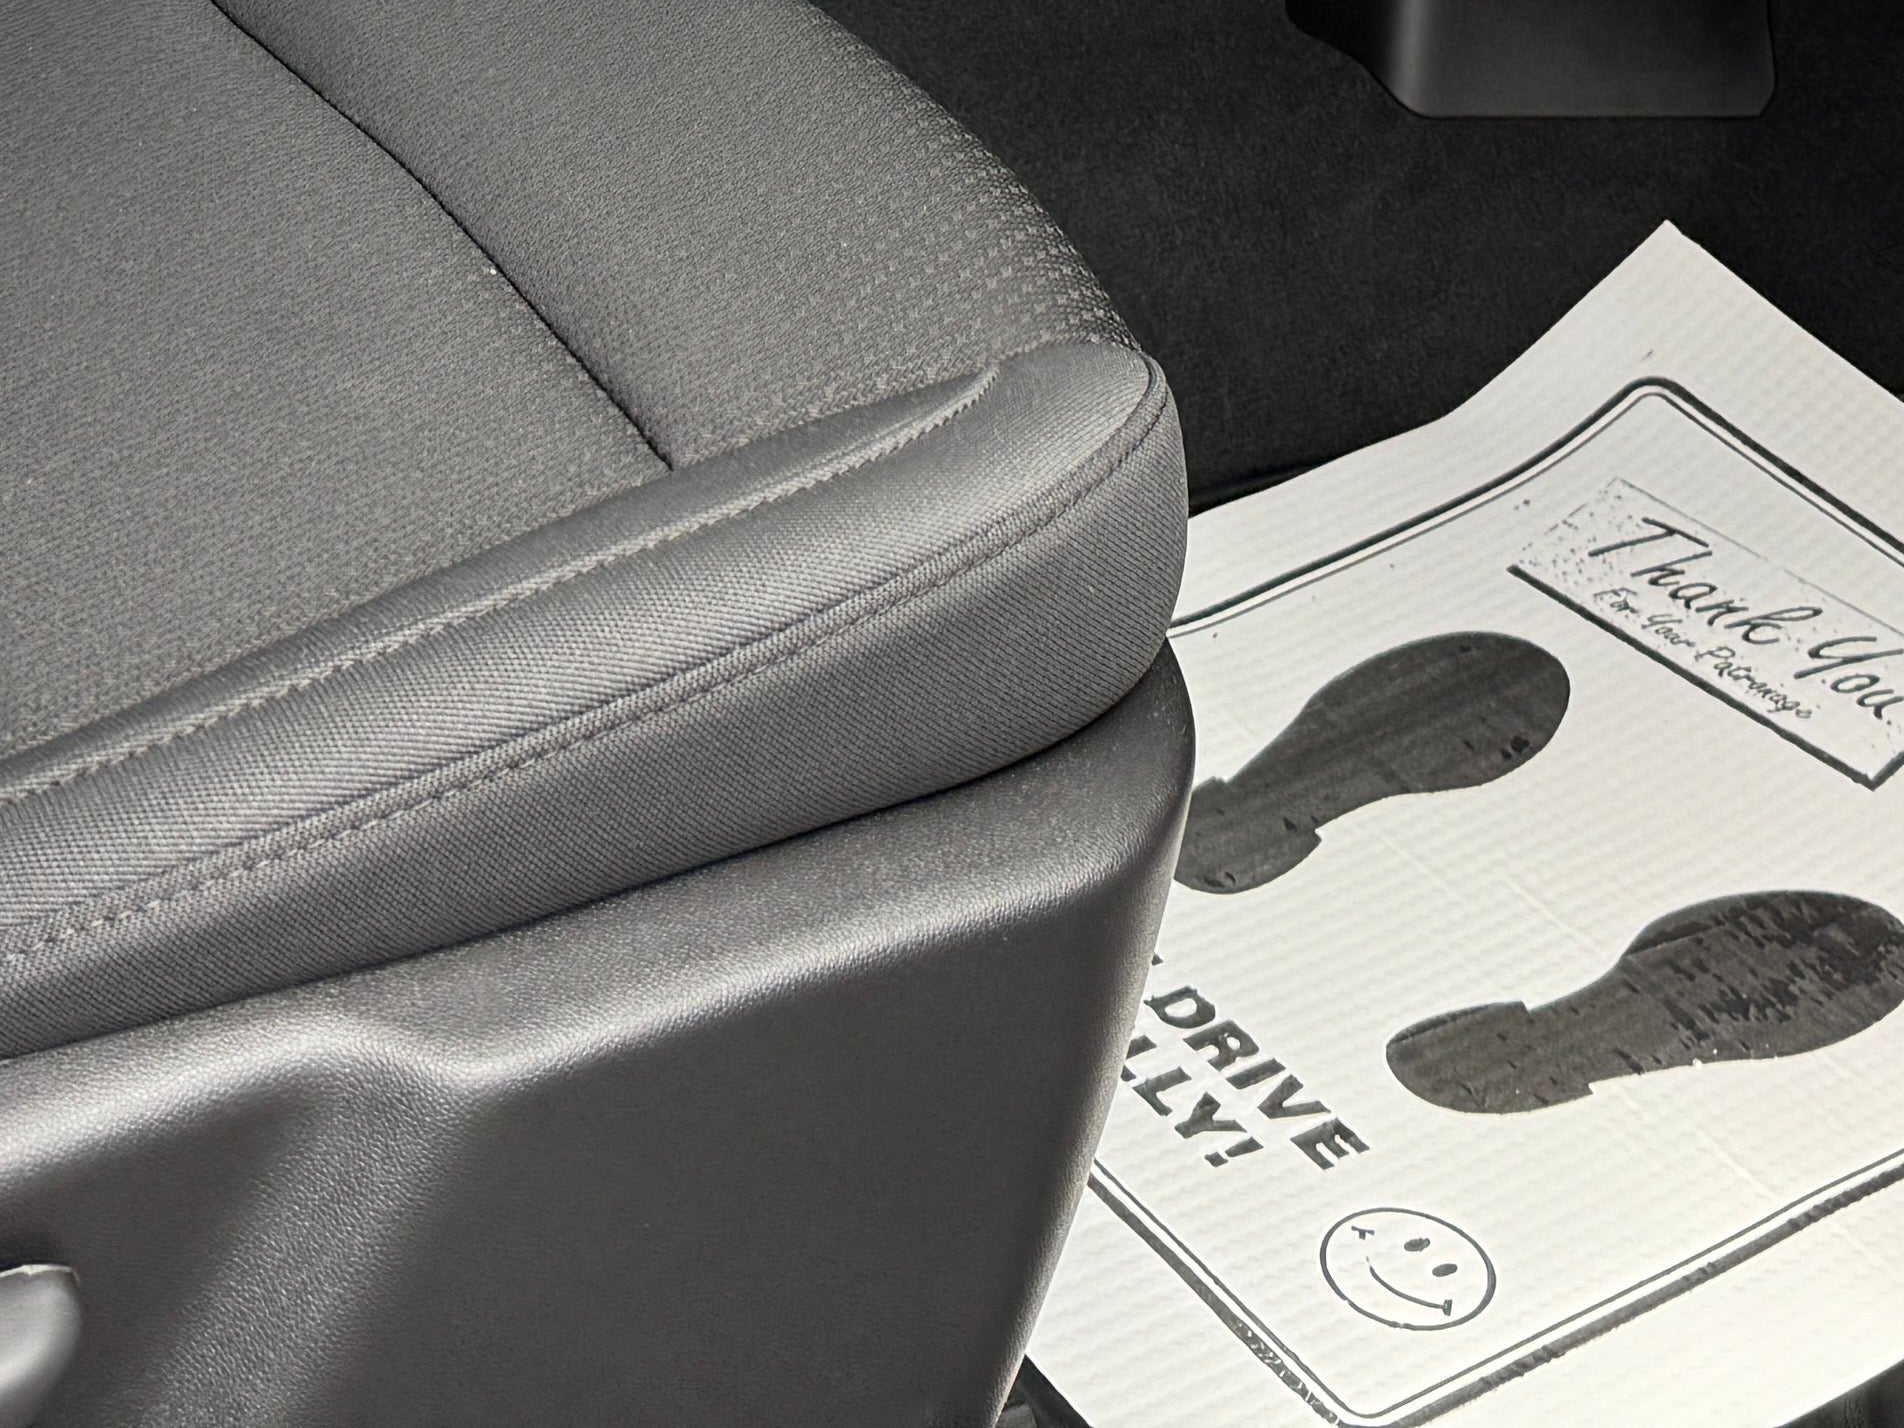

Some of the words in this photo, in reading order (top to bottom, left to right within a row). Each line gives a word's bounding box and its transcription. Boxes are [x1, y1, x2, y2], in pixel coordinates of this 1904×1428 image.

[1589, 517, 1823, 644] Thank
[1794, 636, 1904, 719] You
[1593, 587, 1637, 614] For
[1641, 613, 1696, 648] Your
[1144, 986, 1371, 1171] DRIVE
